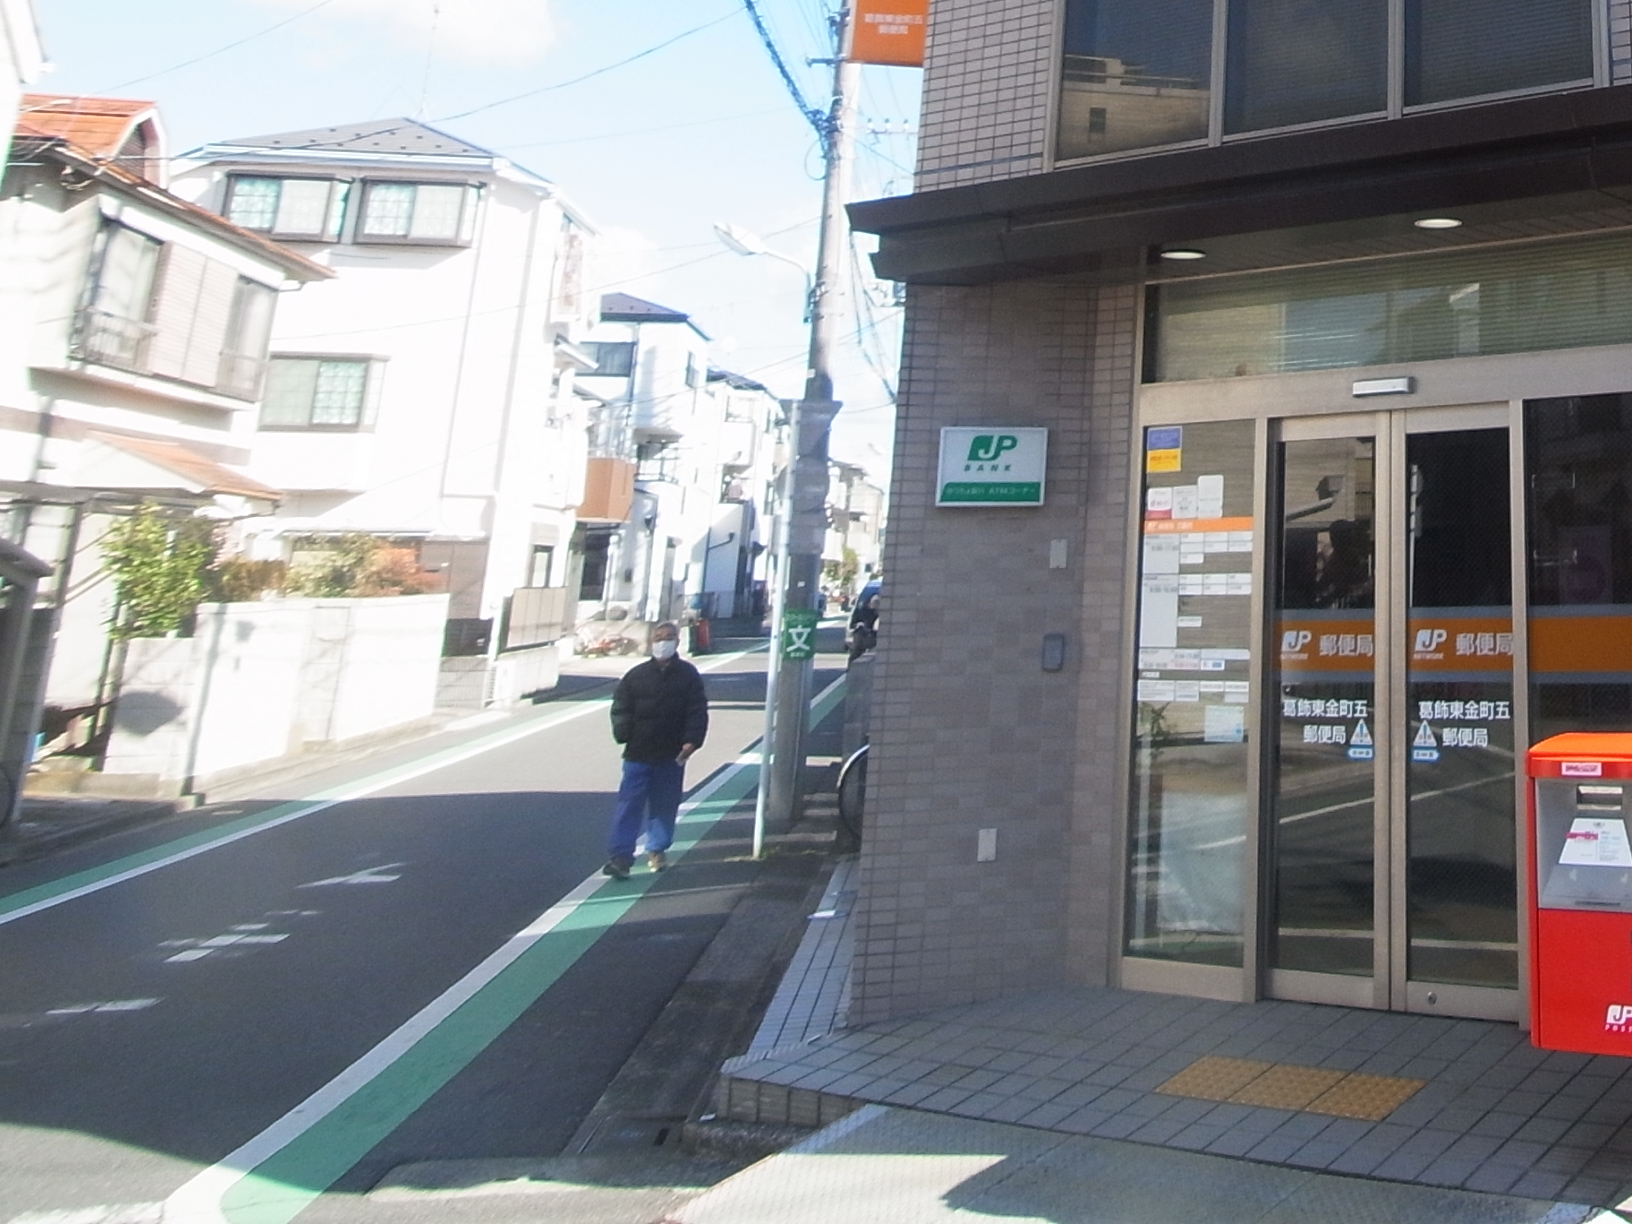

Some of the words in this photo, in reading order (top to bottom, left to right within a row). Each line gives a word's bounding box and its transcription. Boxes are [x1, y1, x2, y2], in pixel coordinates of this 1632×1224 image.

[967, 434, 1018, 461] JP
[963, 464, 1012, 472] BANK
[786, 625, 811, 652] 文
[1319, 634, 1373, 657] 郵便局
[1455, 633, 1513, 657] 郵便局
[1283, 699, 1368, 719] 葛飾東金町五
[1418, 701, 1510, 721] 葛飾東金町五
[1303, 725, 1346, 745] 郵便局
[1442, 728, 1489, 748] 郵便局
